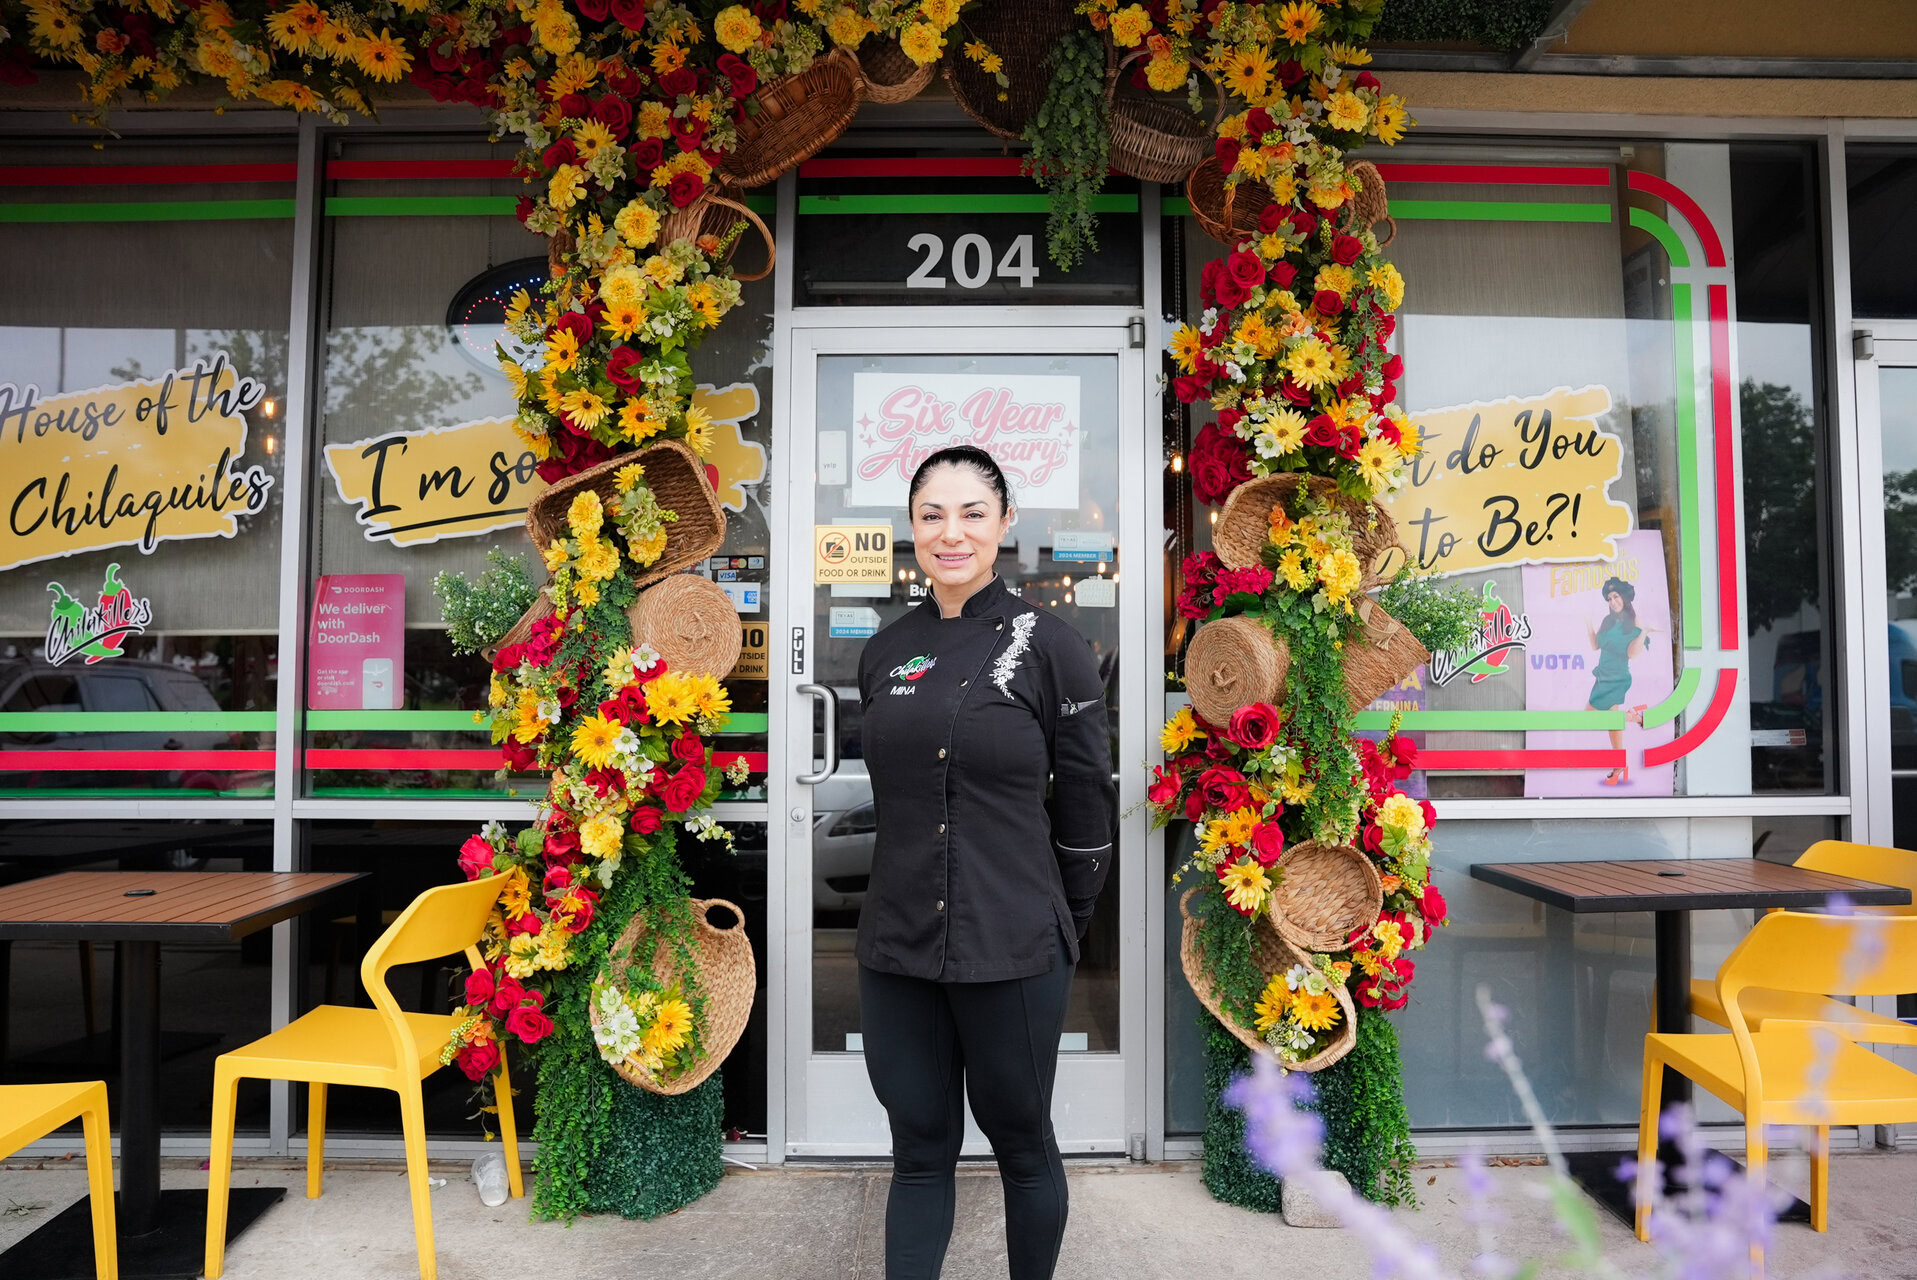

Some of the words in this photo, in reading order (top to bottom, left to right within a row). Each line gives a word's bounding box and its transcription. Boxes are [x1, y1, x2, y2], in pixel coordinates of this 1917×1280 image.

[906, 233, 1039, 288] 204
[0, 387, 126, 444] House
[136, 373, 178, 435] of
[181, 355, 261, 423] the
[877, 386, 956, 441] Six
[960, 388, 1065, 445] Year
[1446, 413, 1503, 474] do
[1514, 409, 1606, 469] You
[858, 436, 1066, 485] Anrsary
[362, 436, 476, 520] I'm
[488, 452, 538, 505] so
[9, 447, 270, 550] Chilaquiles
[855, 532, 886, 551] NO
[1408, 507, 1463, 569] to
[1477, 492, 1582, 557] Be?!
[819, 569, 844, 577] FOOD
[846, 569, 859, 577] OR
[861, 569, 886, 577] DRINK
[850, 556, 888, 564] OUTSIDE
[1550, 557, 1640, 598] Famosos
[319, 603, 340, 614] We
[343, 602, 386, 614] deliver
[318, 618, 345, 630] with
[318, 632, 380, 644] DoorDash
[740, 652, 765, 660] TSIDE
[793, 628, 803, 673] PULL
[1530, 654, 1585, 670] VOTA
[740, 665, 764, 673] DRINK
[889, 685, 916, 696] MINA
